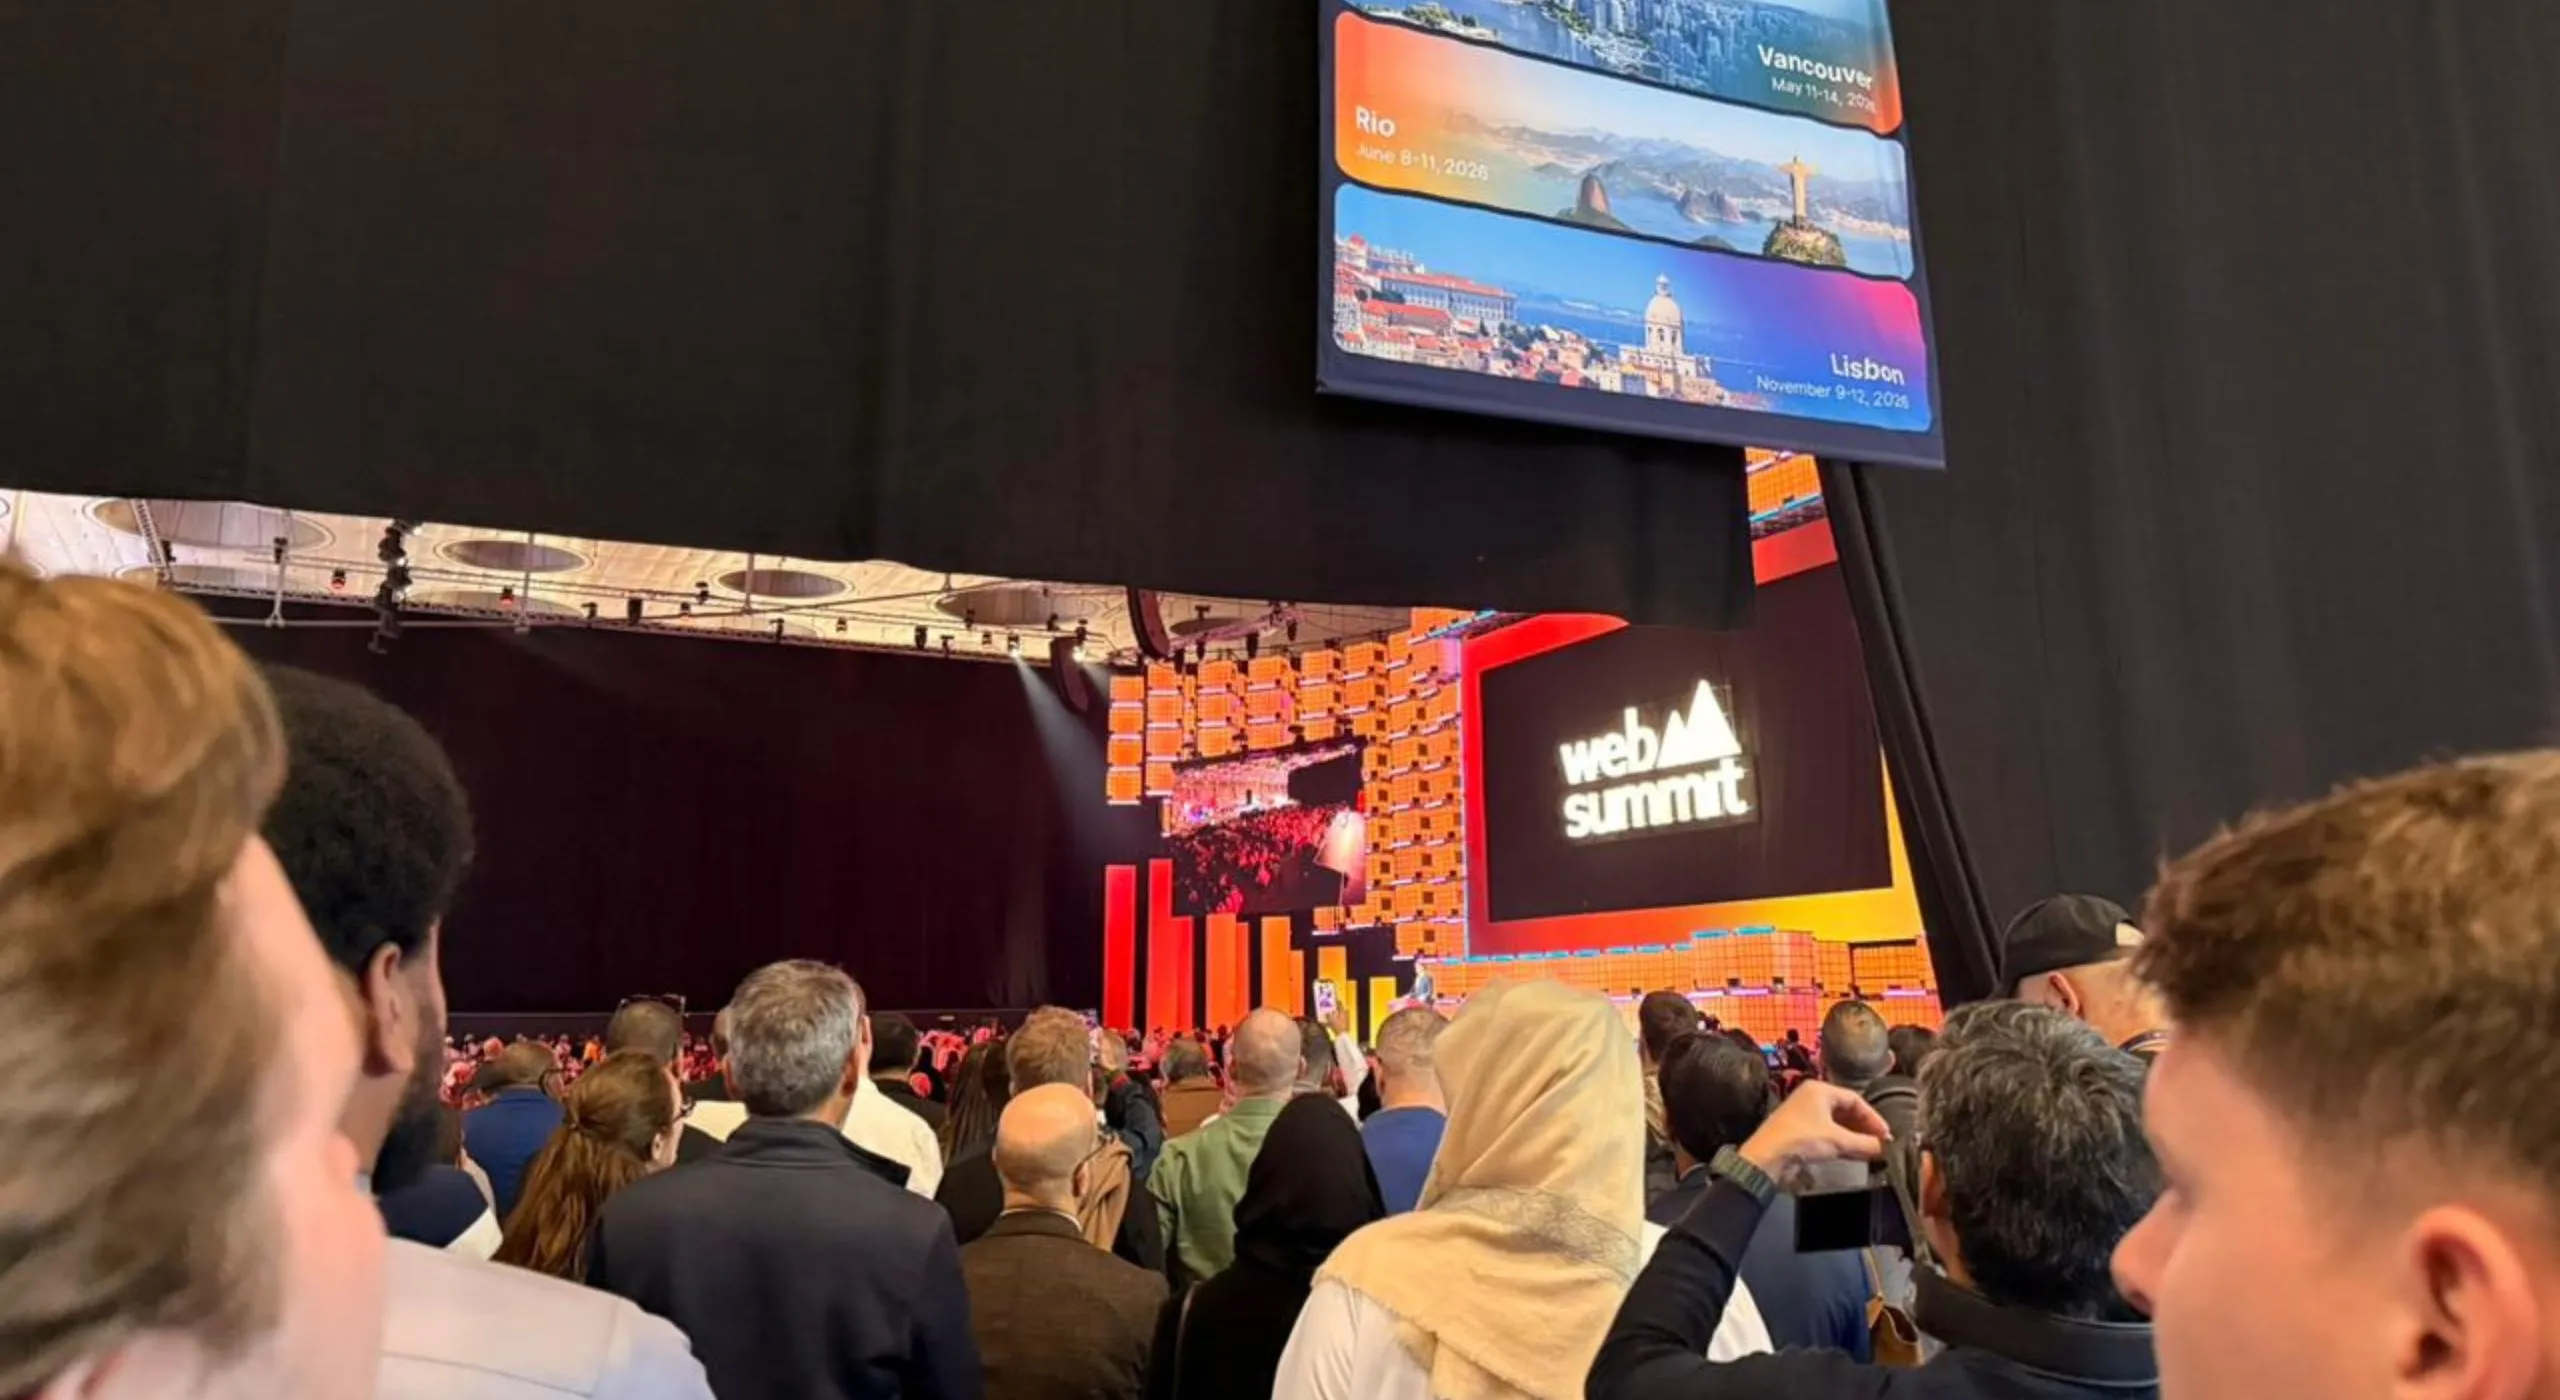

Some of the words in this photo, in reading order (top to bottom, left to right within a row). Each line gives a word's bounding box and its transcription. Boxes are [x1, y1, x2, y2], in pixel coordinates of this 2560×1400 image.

[1757, 43, 1872, 90] Vancouver
[1771, 77, 1802, 96] May
[1805, 83, 1842, 107] 11-14,
[1355, 105, 1396, 138] Rio
[1357, 144, 1396, 165] June
[1401, 150, 1441, 175] 8-11,
[1444, 158, 1489, 182] 2026
[1829, 352, 1905, 386] Lisbon
[1756, 374, 1832, 398] November
[1834, 384, 1870, 406] 9-12,
[1559, 706, 1660, 785] web
[1563, 757, 1749, 838] summit
